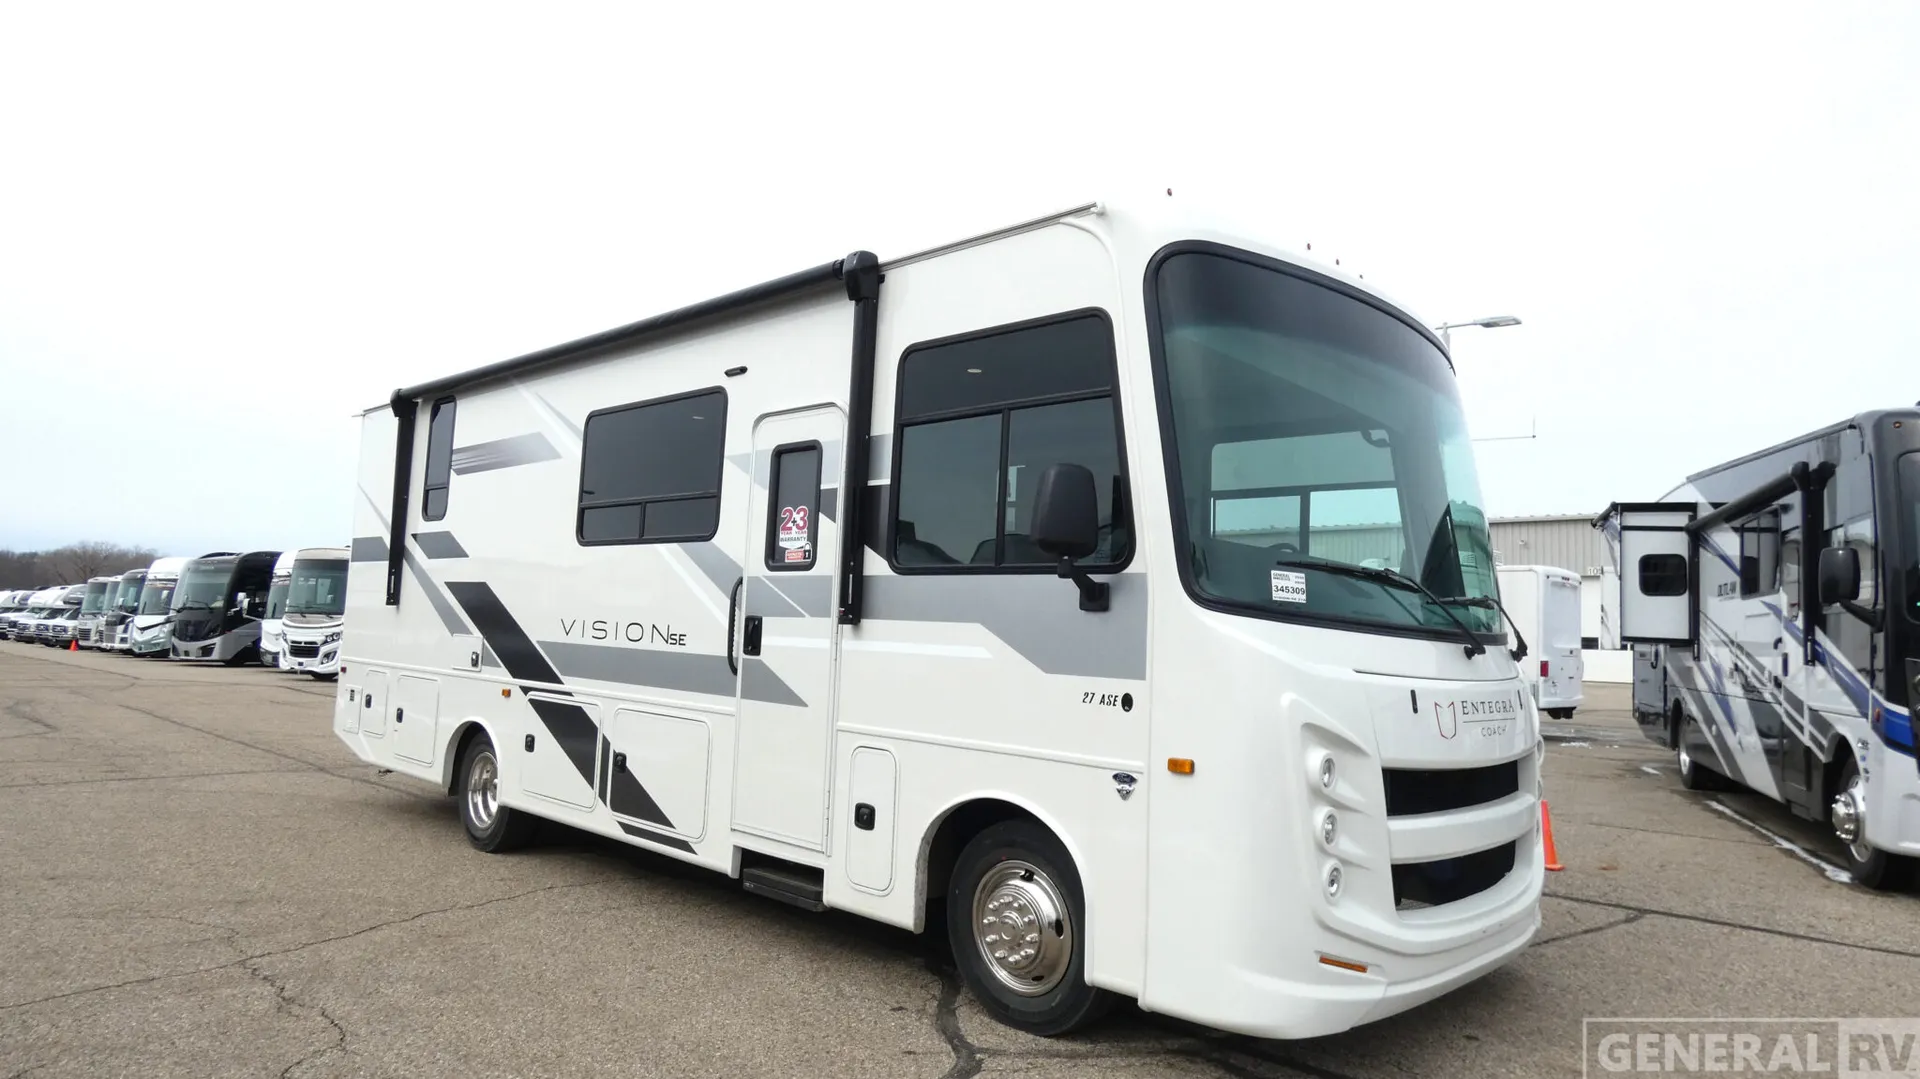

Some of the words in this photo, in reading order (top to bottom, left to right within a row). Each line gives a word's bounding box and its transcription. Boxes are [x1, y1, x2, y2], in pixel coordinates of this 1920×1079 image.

[1273, 584, 1305, 595] 345309
[560, 618, 670, 644] VISION
[1082, 691, 1095, 704] 27
[1099, 693, 1119, 707] ASE
[1461, 699, 1515, 715] ENTEGRA
[1480, 725, 1507, 737] COACH
